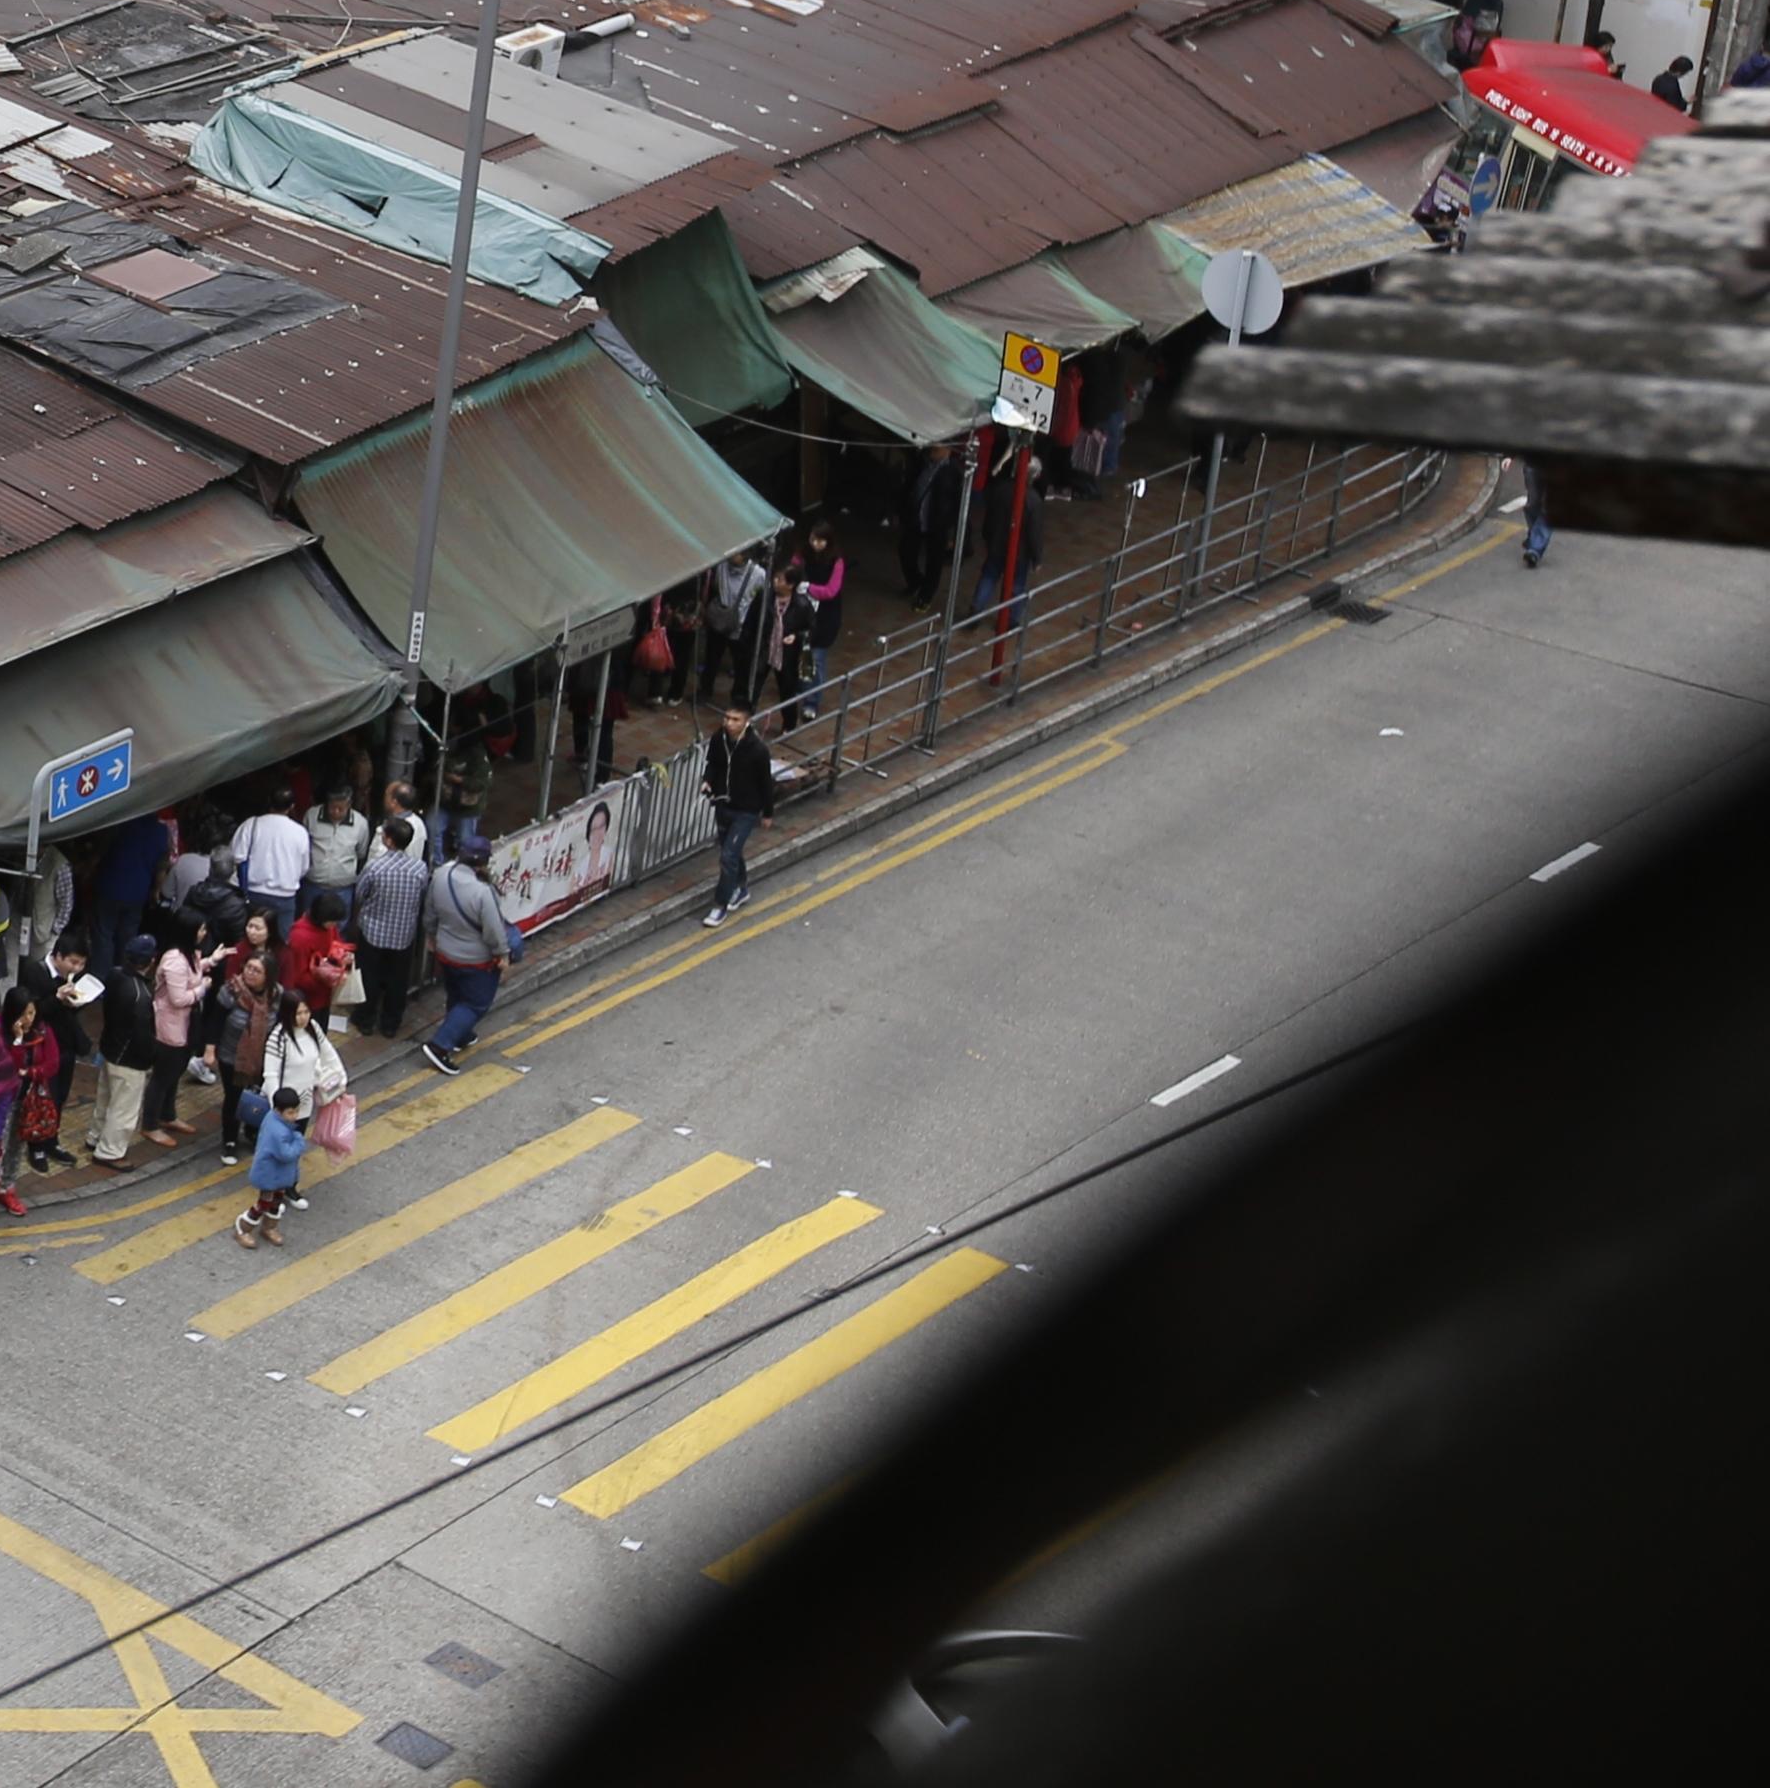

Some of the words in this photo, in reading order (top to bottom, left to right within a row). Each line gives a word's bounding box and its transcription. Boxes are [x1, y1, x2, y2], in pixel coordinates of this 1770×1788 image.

[1485, 88, 1511, 112] PUBLIC
[1510, 104, 1533, 124] LIGHT
[1532, 117, 1549, 136] BUS
[1560, 133, 1586, 157] SEATS
[1035, 385, 1043, 401] 7
[1031, 411, 1048, 428] 12
